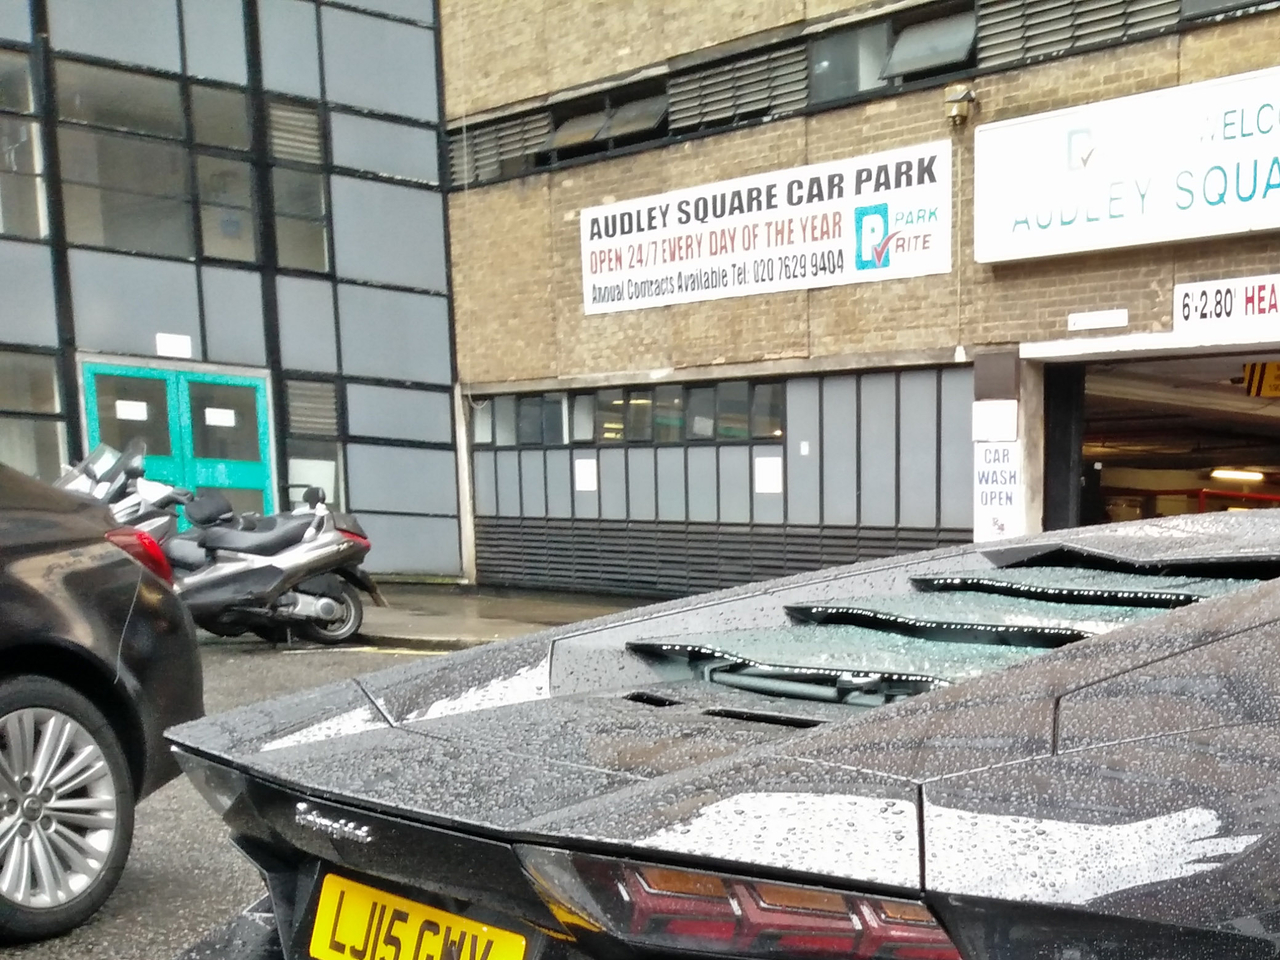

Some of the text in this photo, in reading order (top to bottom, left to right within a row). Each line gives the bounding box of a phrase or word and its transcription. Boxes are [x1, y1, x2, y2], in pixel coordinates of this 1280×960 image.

[589, 155, 938, 241] AUDLEY SQUARE CAR PARK
[895, 207, 938, 226] PARK
[590, 211, 842, 275] OPEN 24/7 EVERY DAY OF THE YEAR
[895, 233, 932, 253] RITE
[592, 248, 844, 305] Annual Contracts Available Tel: 020 7629 9404
[984, 448, 1010, 464] CAR
[977, 470, 1017, 485] WASH
[980, 491, 1013, 506] OPEN
